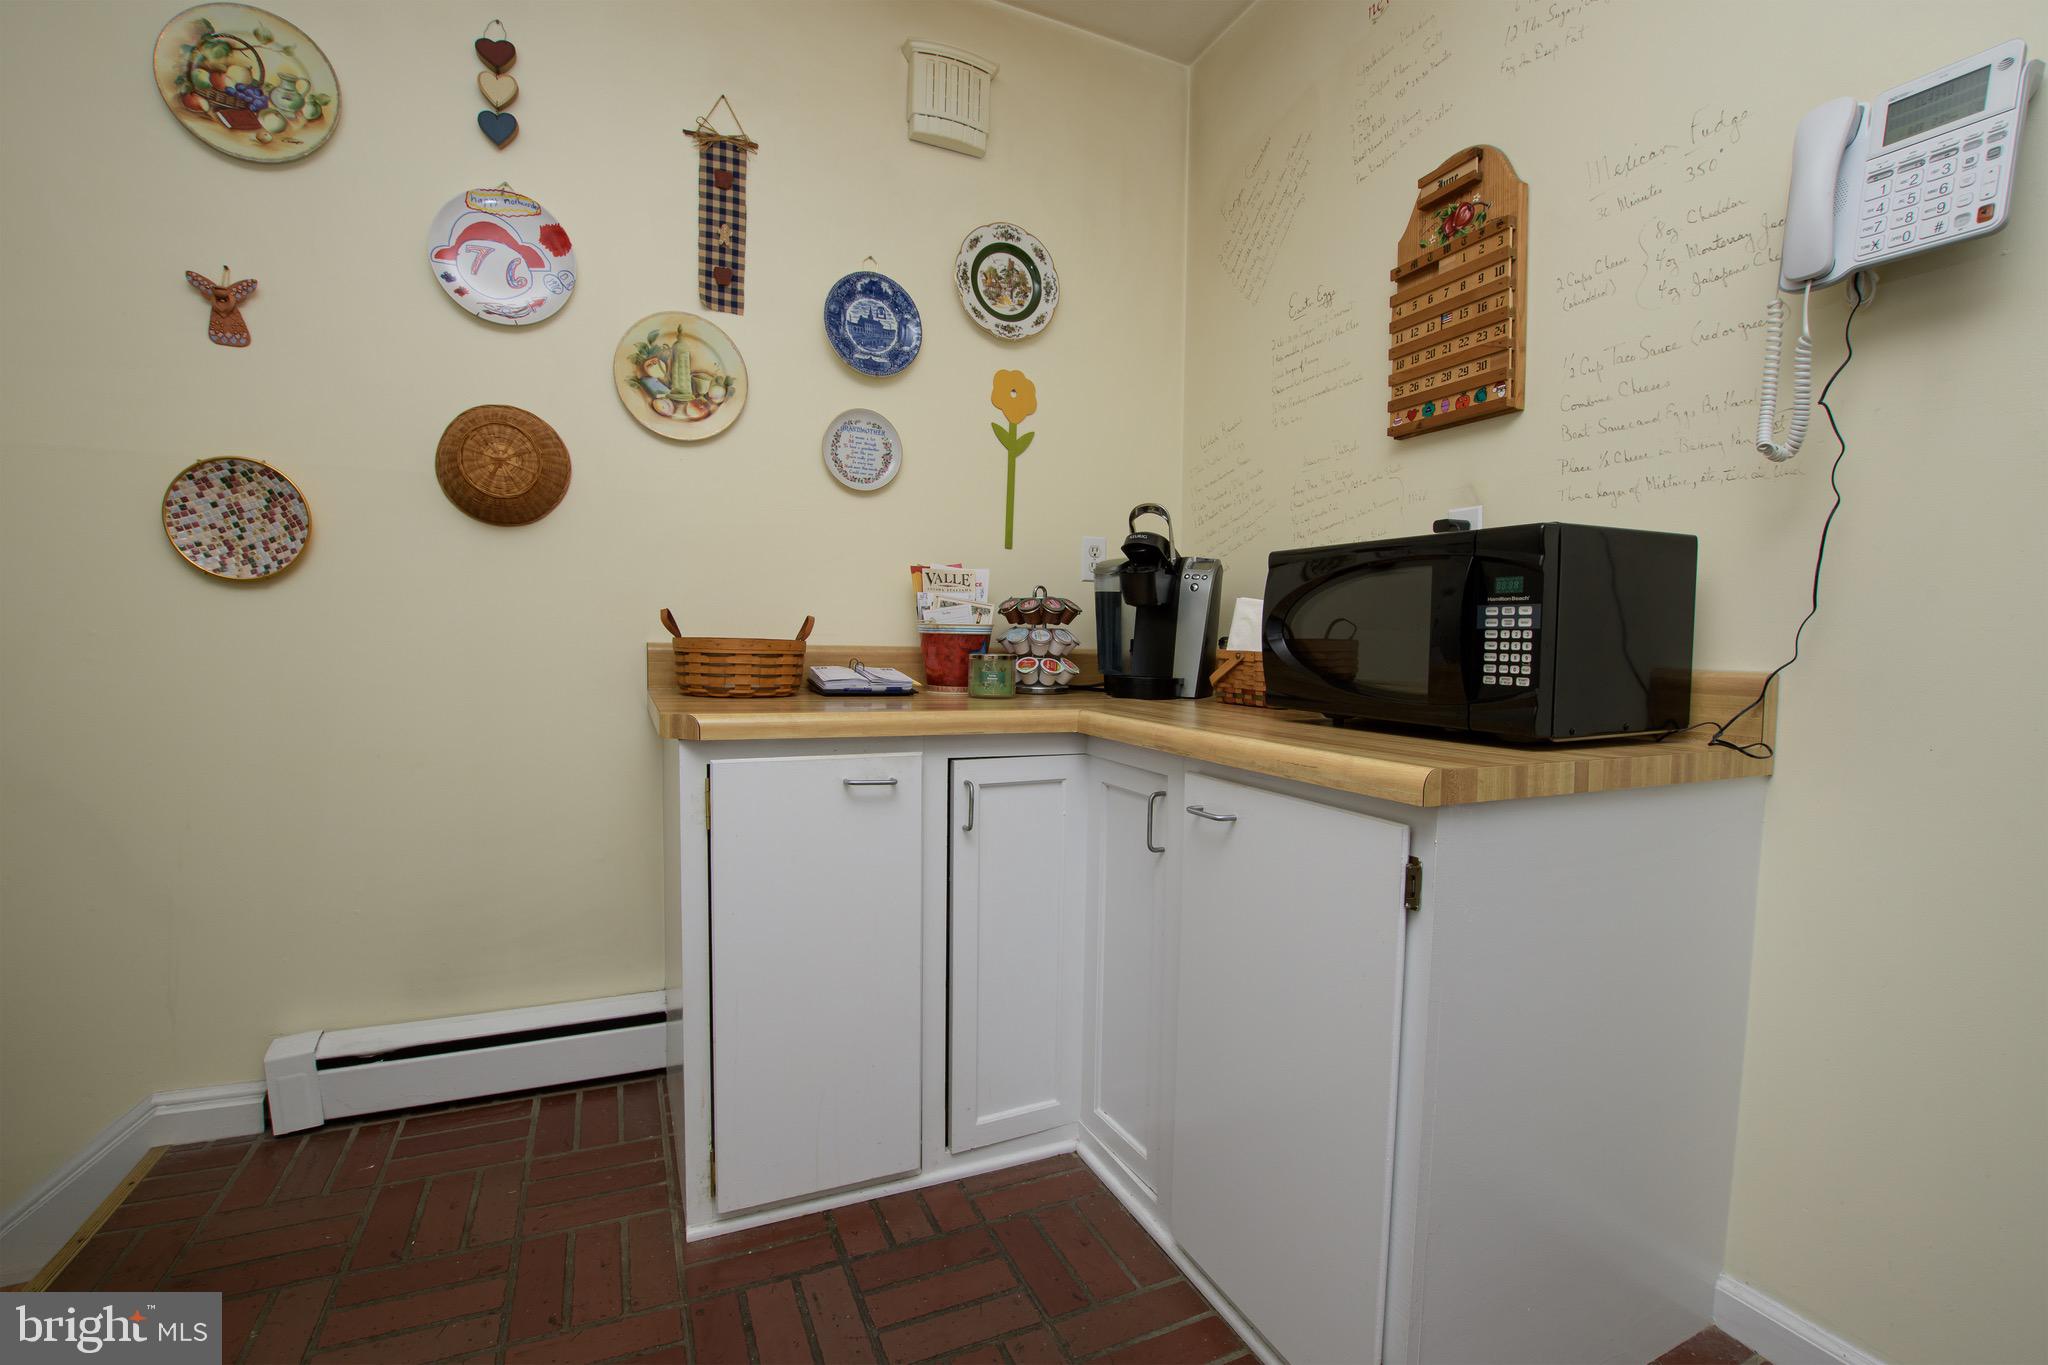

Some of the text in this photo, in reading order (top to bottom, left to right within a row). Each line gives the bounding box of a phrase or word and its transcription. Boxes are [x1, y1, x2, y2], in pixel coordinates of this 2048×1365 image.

[1438, 174, 1459, 188] June
[1880, 184, 1886, 195] 1
[1909, 173, 1919, 186] 2
[1941, 163, 1951, 174] 3
[1687, 197, 1749, 224] Cheddar
[1875, 202, 1884, 213] 4
[1906, 192, 1916, 204] 5
[1939, 183, 1948, 194] 6
[1760, 213, 1786, 250] Jac
[1874, 221, 1882, 233] 7
[1905, 211, 1913, 223] 8
[1936, 202, 1946, 213] 9
[1902, 231, 1911, 242] 0
[1753, 248, 1783, 267] Che
[1396, 296, 1505, 344] 11 12 13 15 16 17
[1396, 324, 1506, 370] 18 19 20 21 22 23 24
[1580, 356, 1604, 383] Cup
[1604, 342, 1635, 366] Taco
[1640, 335, 1683, 360] Sauce
[1394, 360, 1487, 397] 25 26 27 28 29 30
